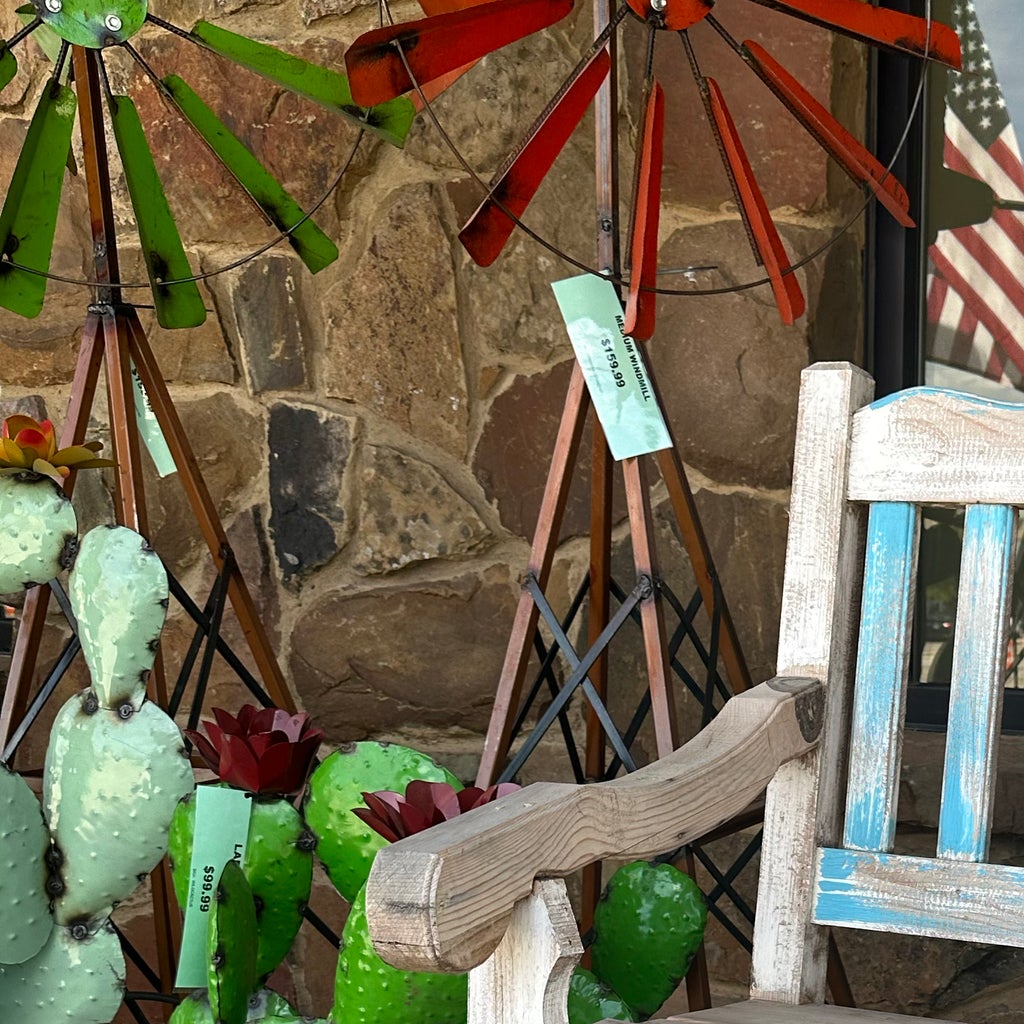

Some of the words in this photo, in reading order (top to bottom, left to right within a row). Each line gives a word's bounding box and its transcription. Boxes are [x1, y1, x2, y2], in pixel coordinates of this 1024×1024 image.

[601, 338, 626, 388] $159.99
[629, 354, 652, 402] WINDMILL
[200, 866, 214, 912] $99.99
